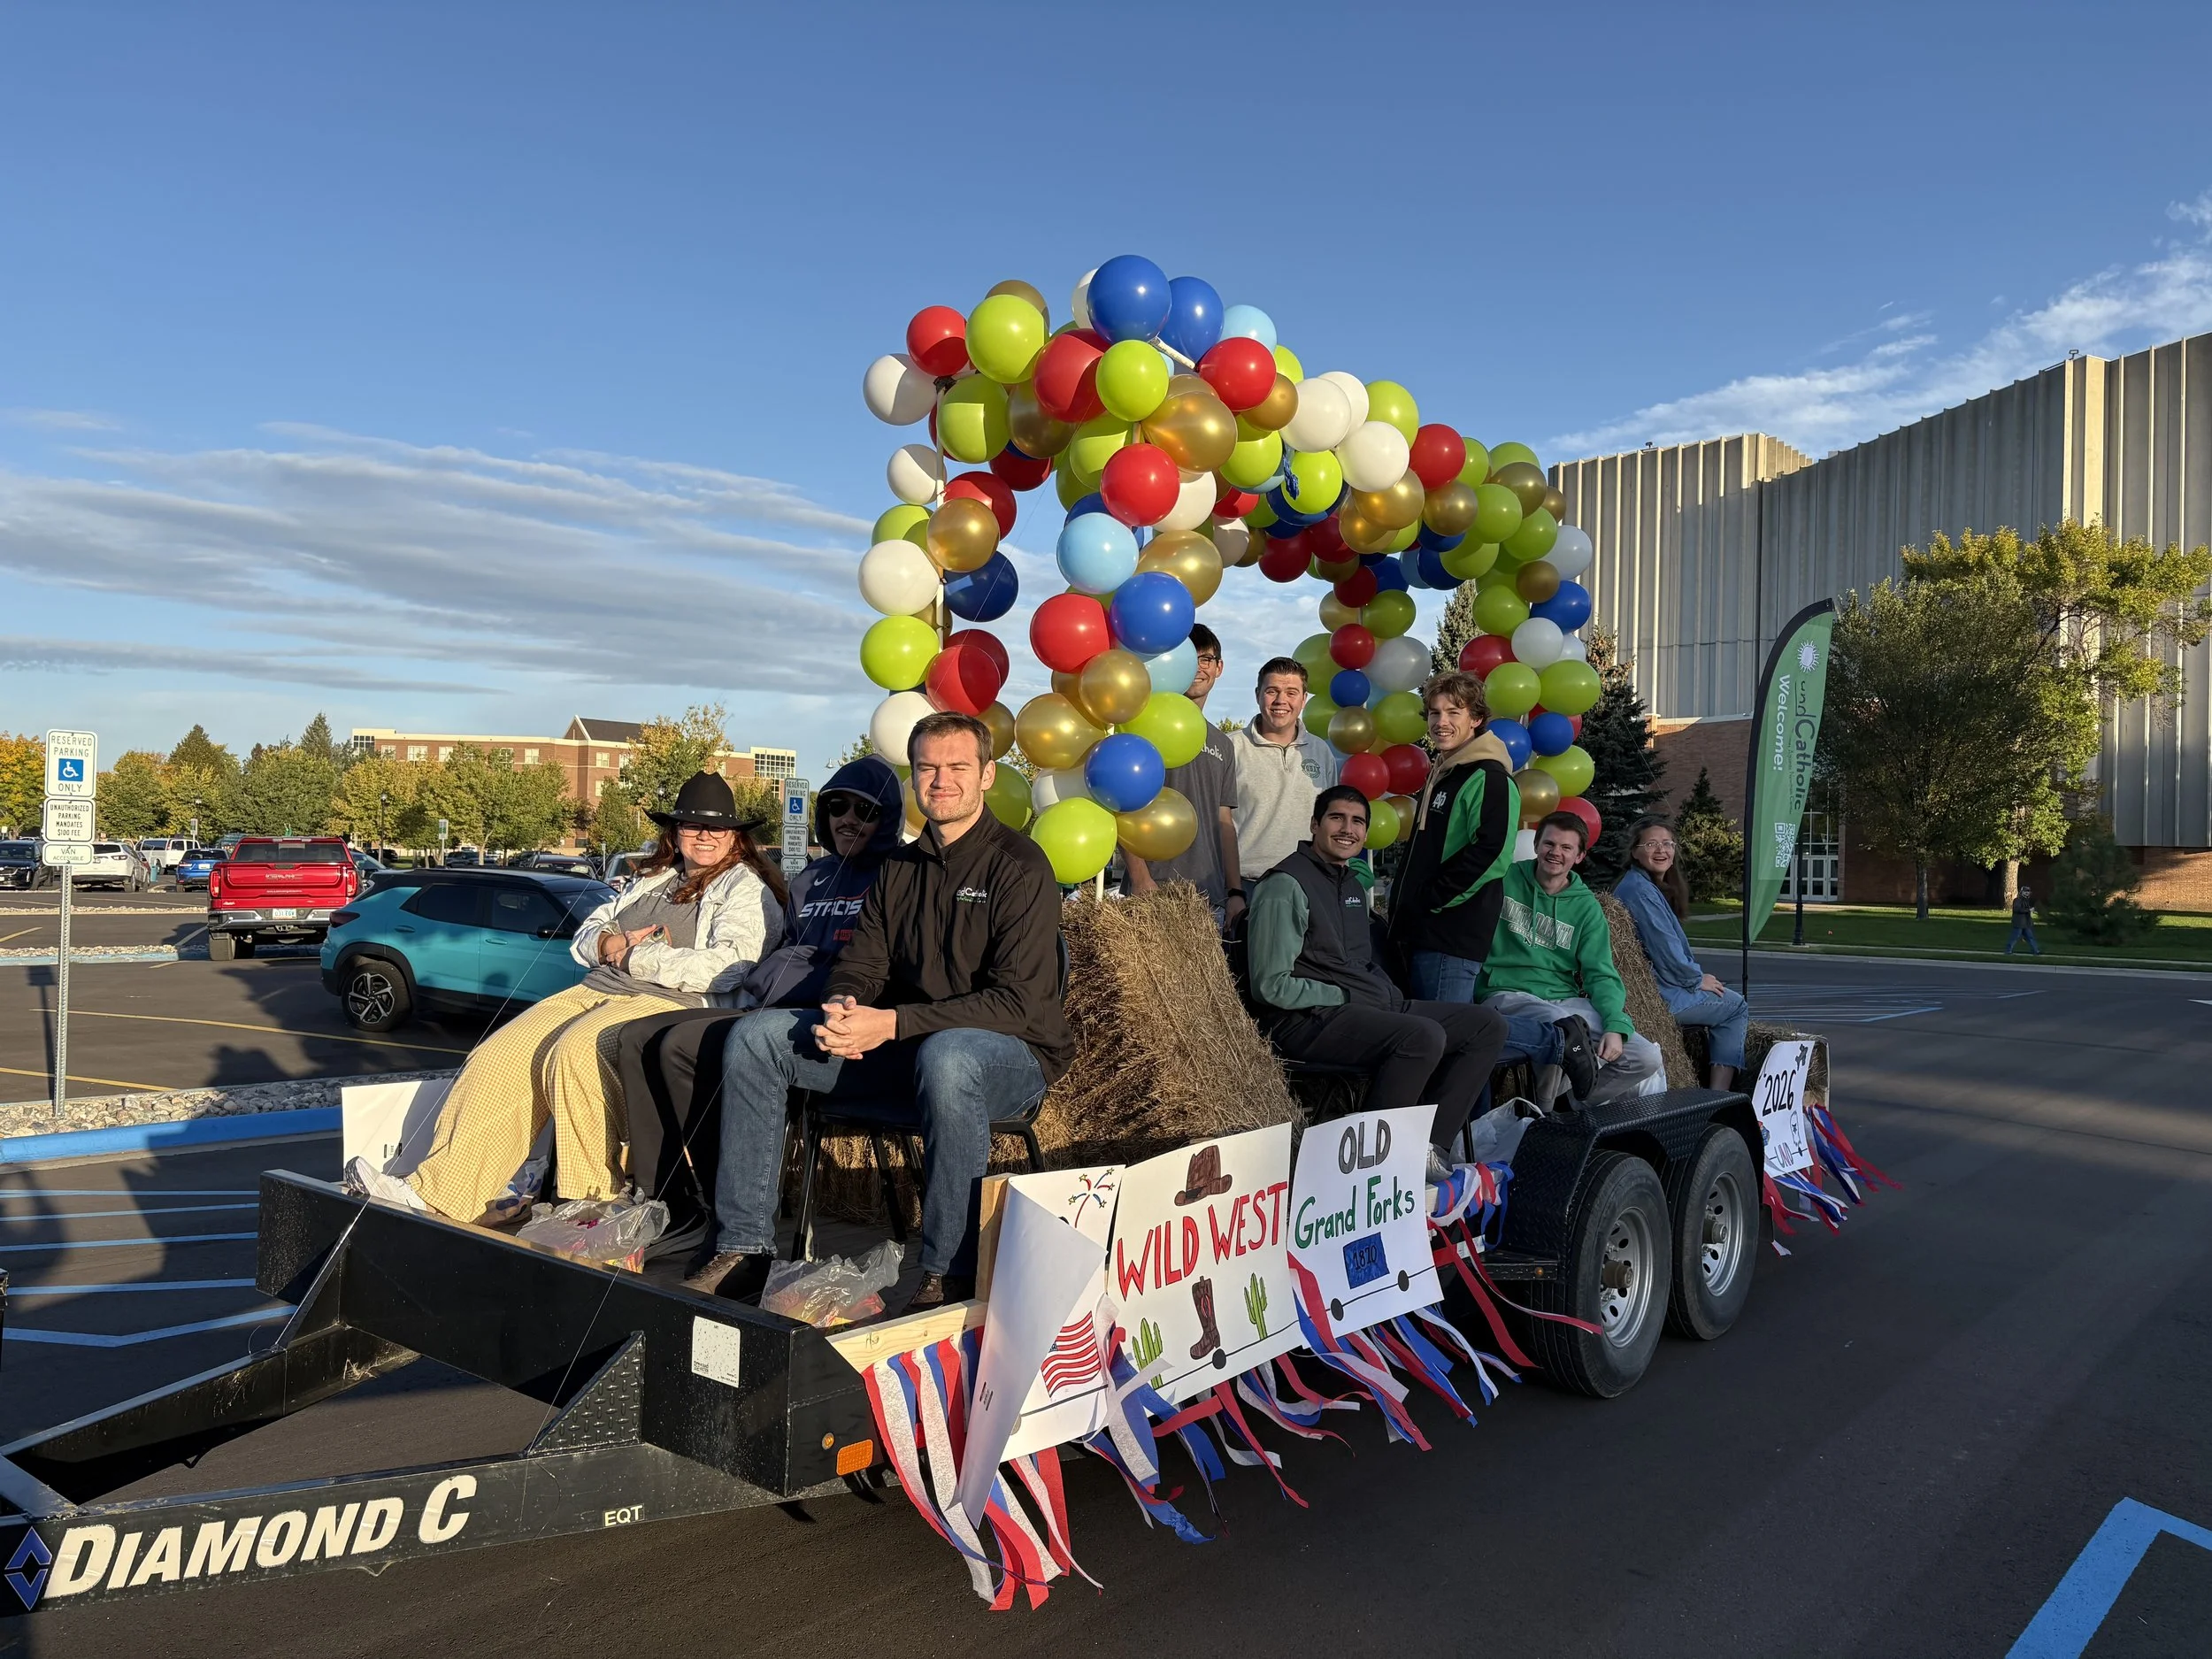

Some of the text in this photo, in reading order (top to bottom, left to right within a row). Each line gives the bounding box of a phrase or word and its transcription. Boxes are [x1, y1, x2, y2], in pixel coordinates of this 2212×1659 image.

[51, 735, 92, 746] RESERVED
[1772, 673, 1791, 771] Welcome!
[54, 747, 89, 757] PARKING
[58, 783, 82, 793] ONLY
[1763, 1070, 1796, 1117] 2026
[1339, 1119, 1391, 1174] OLD
[1294, 1175, 1415, 1248] Grand Forks
[1118, 1181, 1287, 1302] WILD WEST
[1353, 1245, 1378, 1270] 1870
[42, 1474, 477, 1599] DIAMOND C
[604, 1505, 643, 1527] EQT
